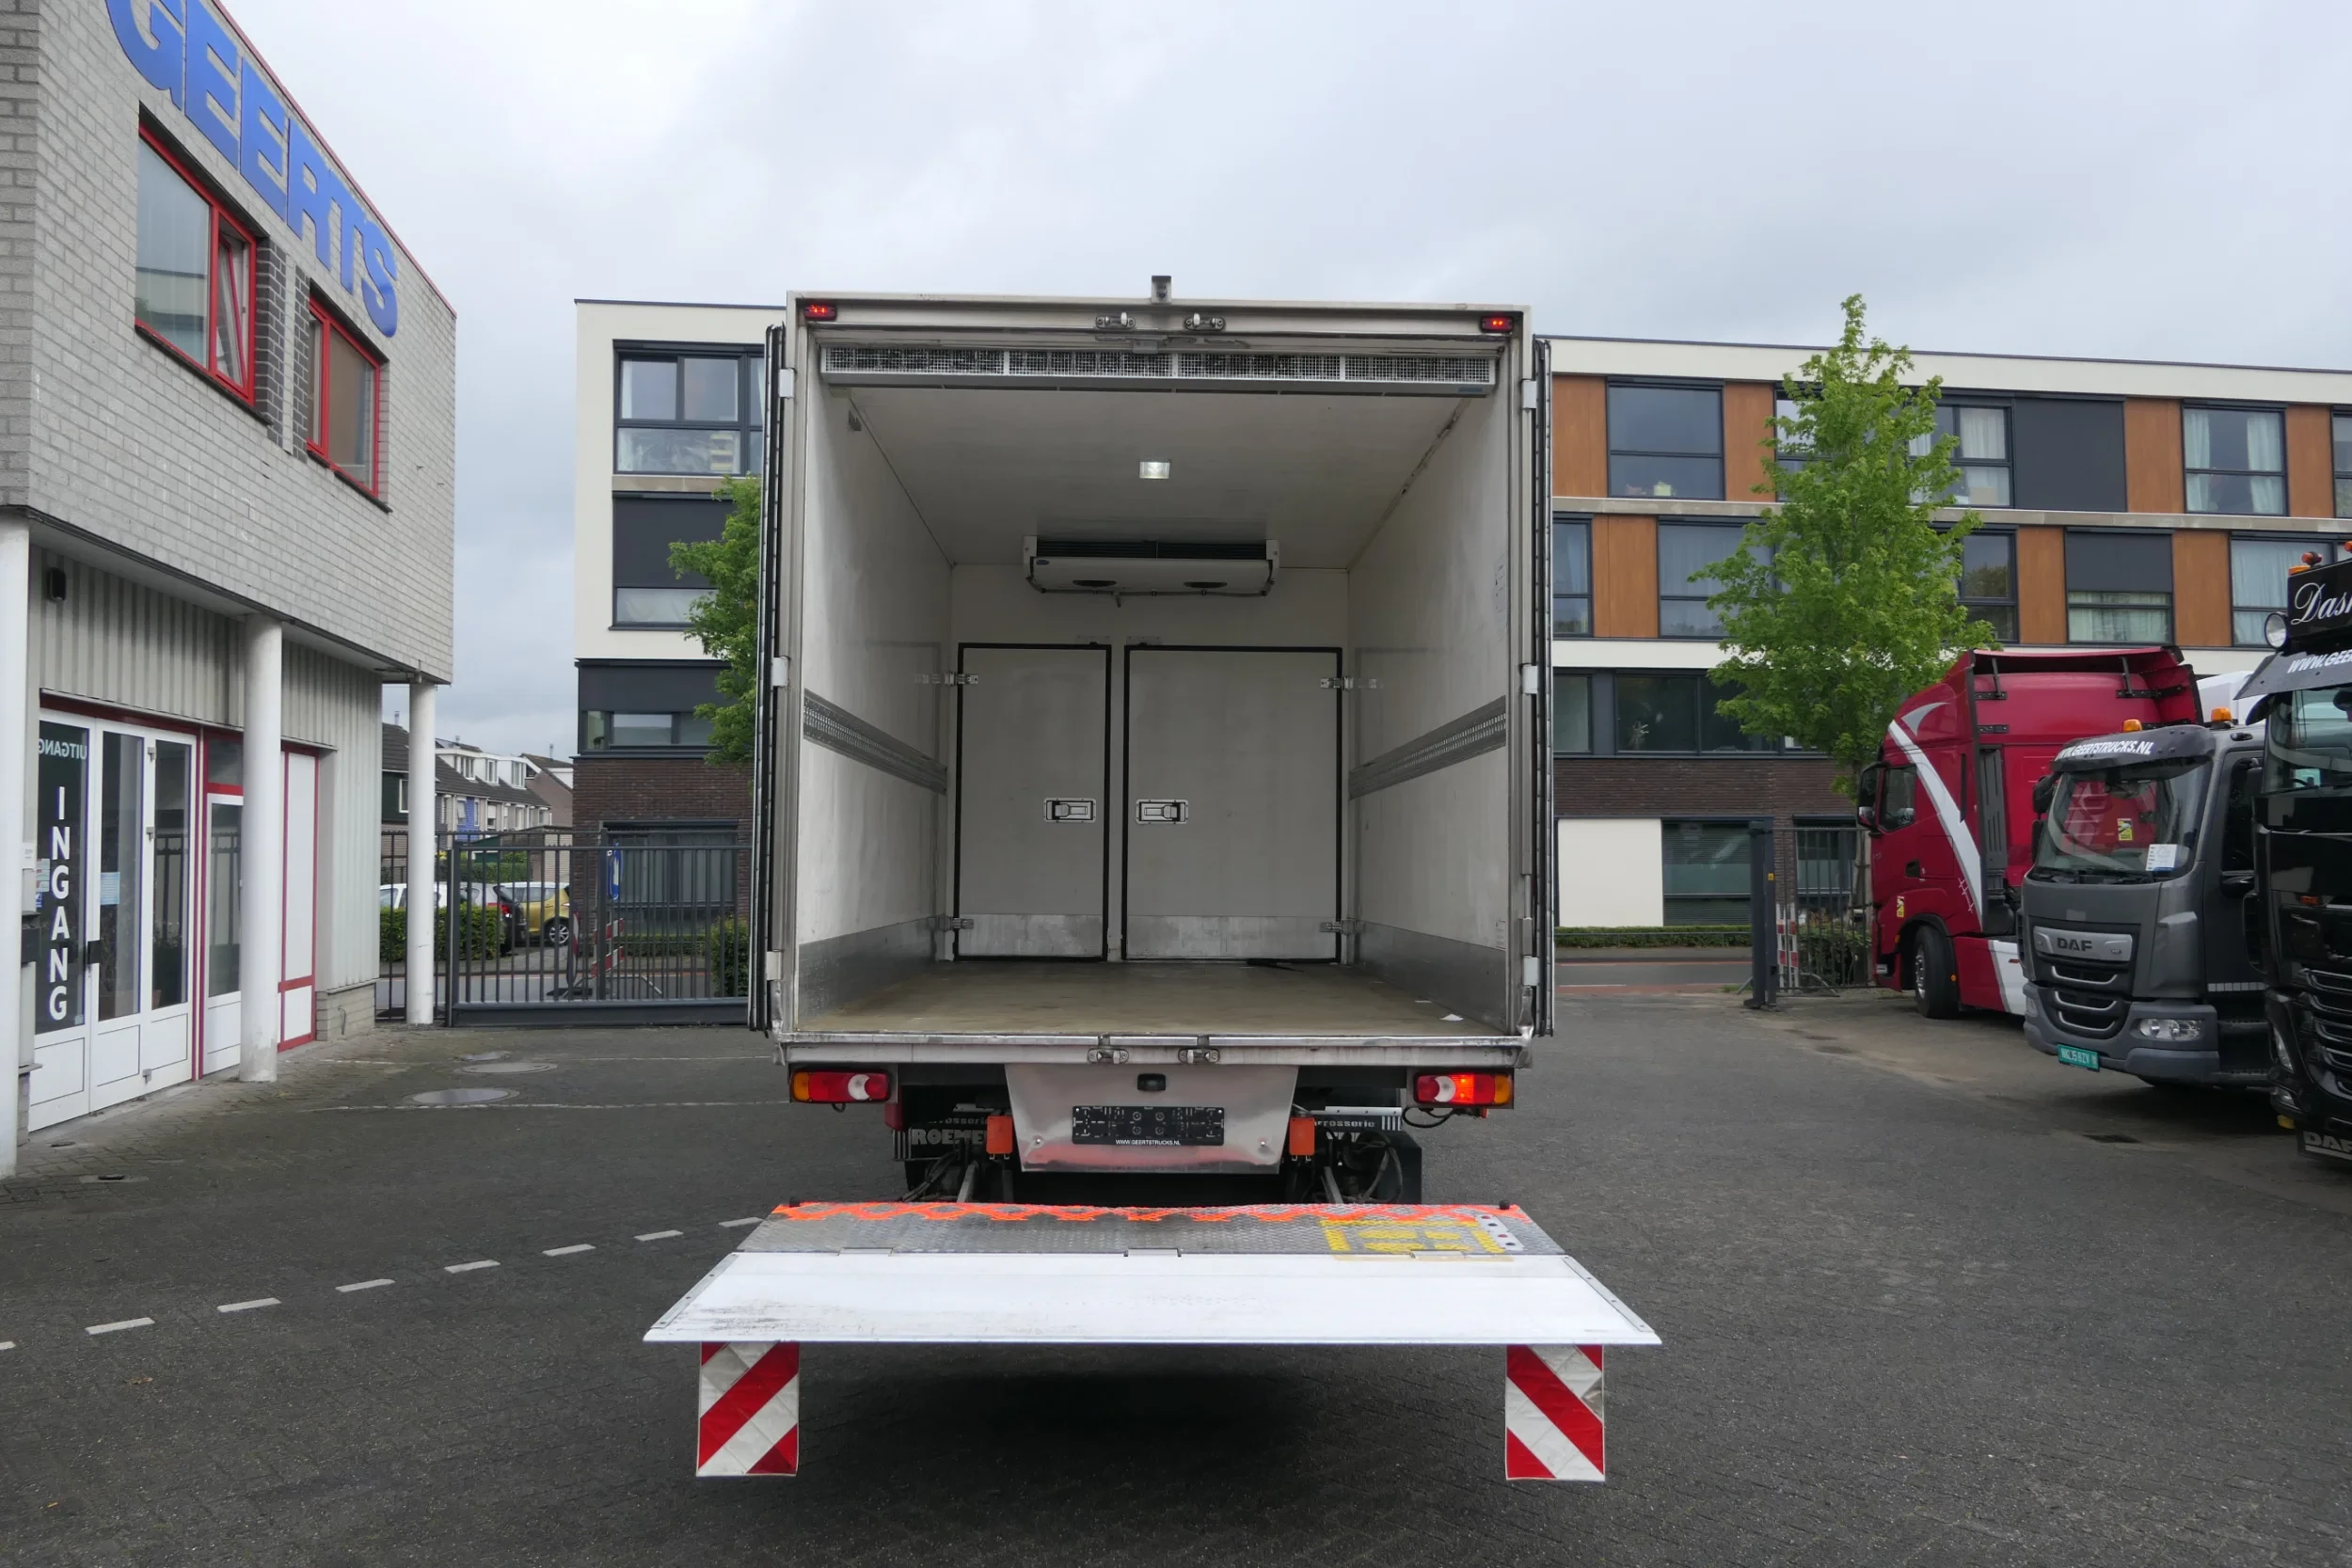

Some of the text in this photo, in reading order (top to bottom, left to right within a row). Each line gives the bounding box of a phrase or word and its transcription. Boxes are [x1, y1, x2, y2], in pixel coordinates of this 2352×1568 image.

[106, 0, 398, 338] GEERTS
[50, 786, 71, 1021] INGANG
[2057, 937, 2092, 952] DAF
[911, 1129, 987, 1145] ROEME
